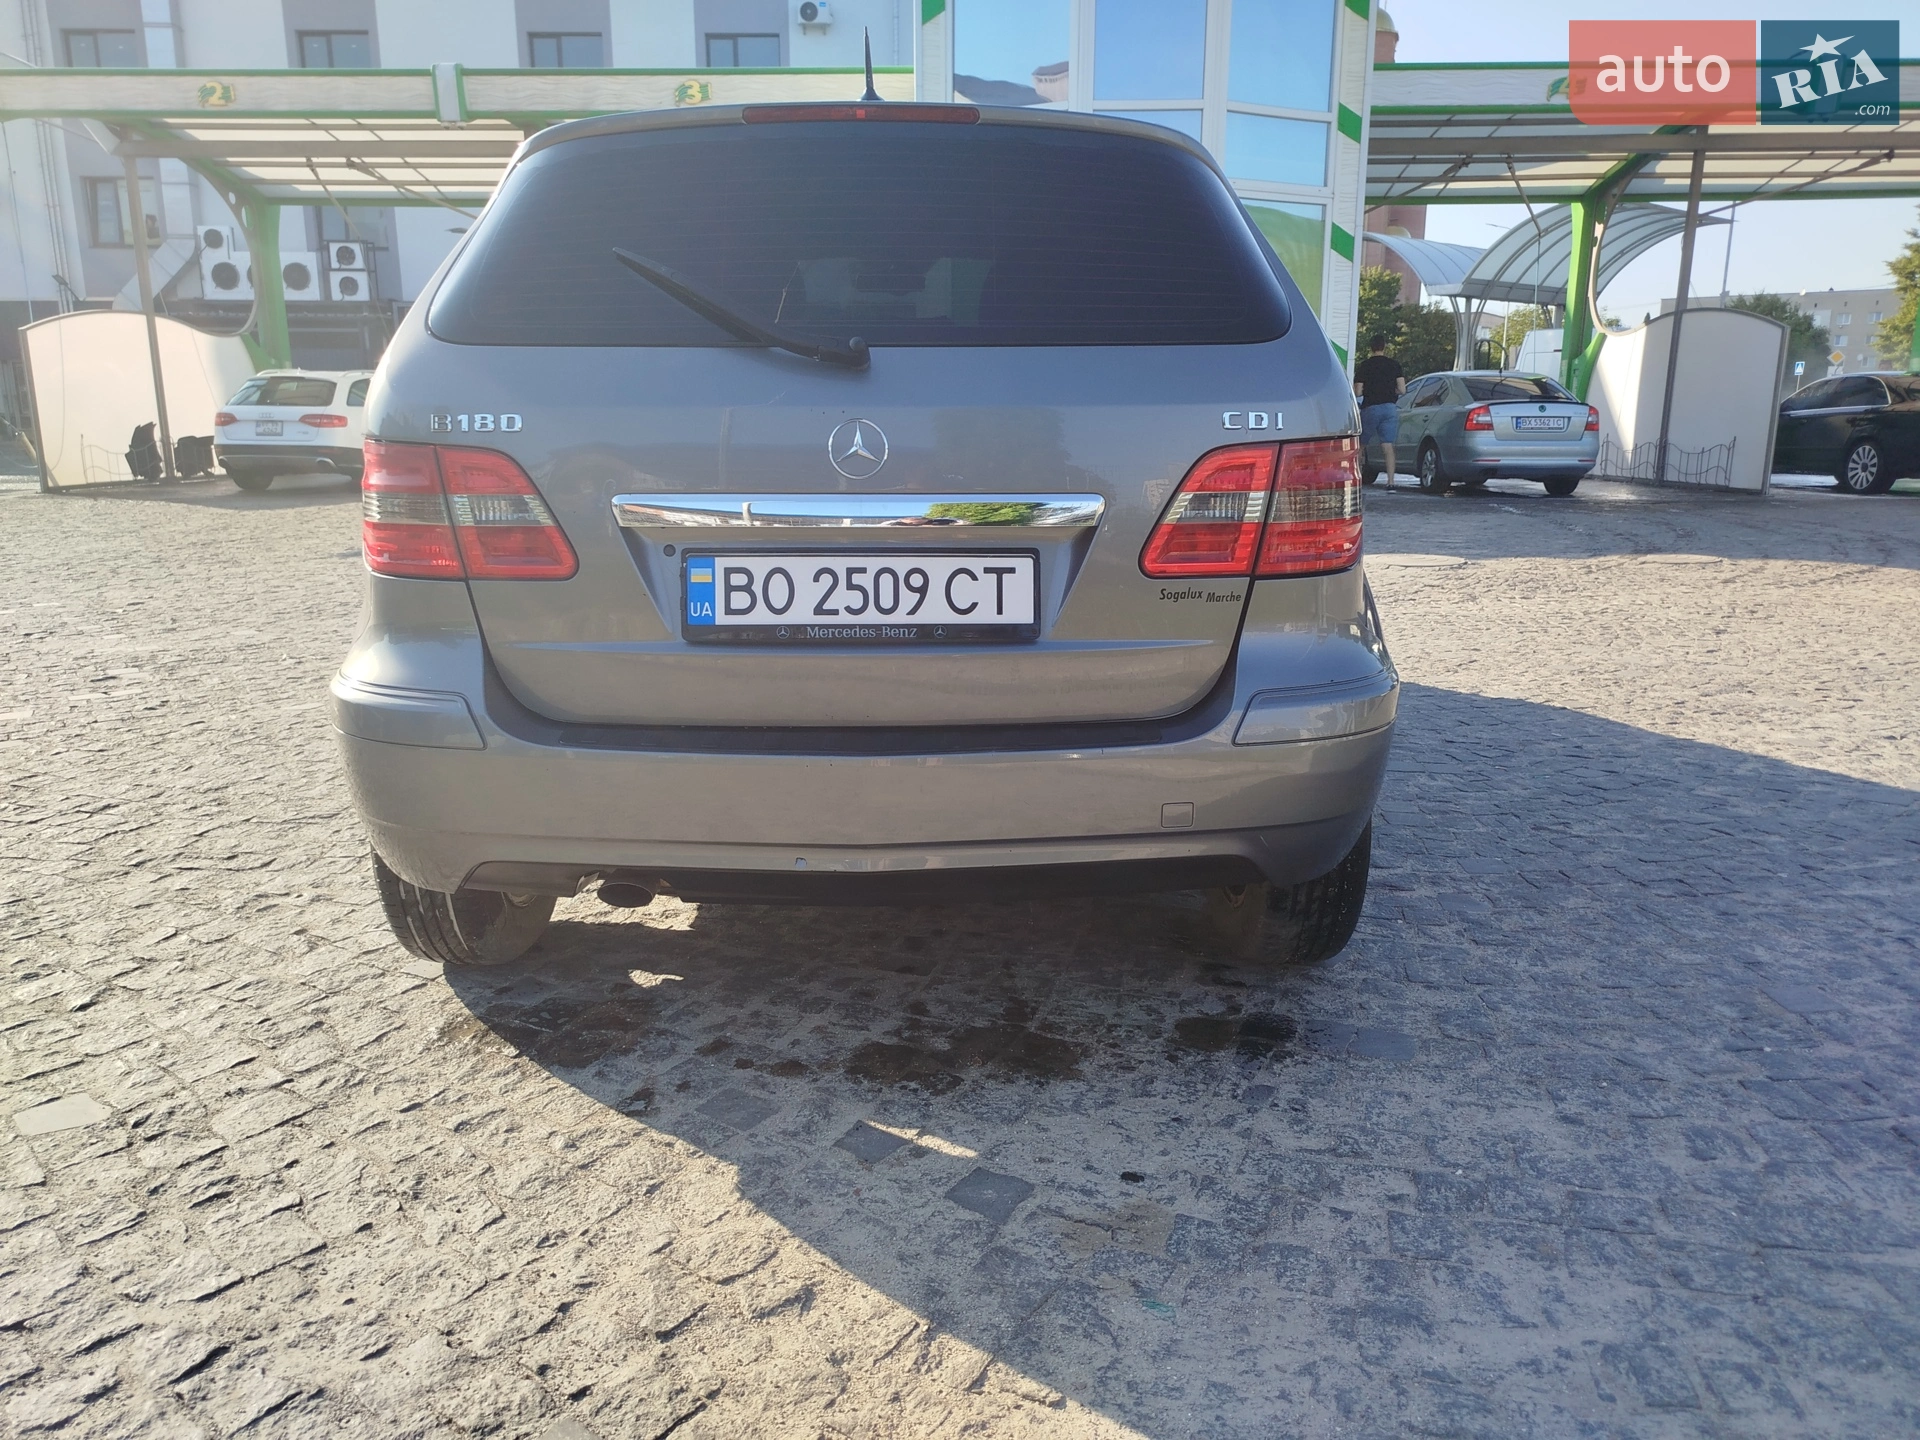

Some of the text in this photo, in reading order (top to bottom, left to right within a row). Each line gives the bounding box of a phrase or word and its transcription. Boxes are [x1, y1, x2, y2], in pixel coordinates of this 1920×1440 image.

[205, 81, 226, 106] 2
[683, 79, 702, 105] 3
[1222, 411, 1284, 430] CDI
[724, 566, 1017, 616] BO 2509 CT
[1159, 587, 1242, 603] Sogalux Marche
[690, 601, 713, 617] UA
[806, 625, 918, 639] Mercedes-Benz
